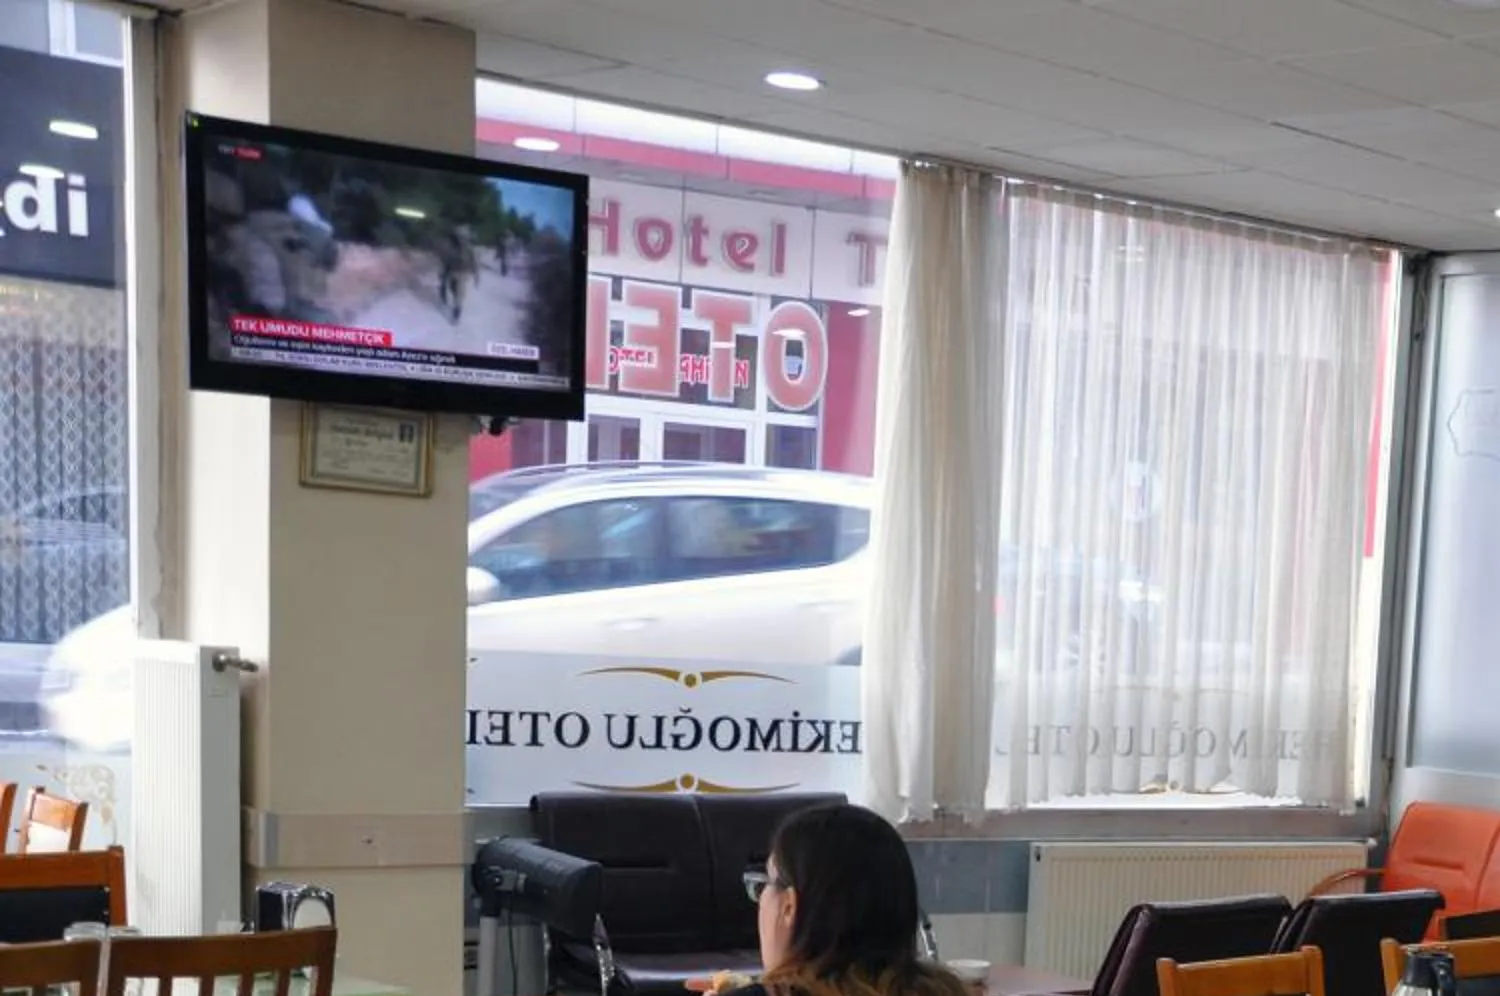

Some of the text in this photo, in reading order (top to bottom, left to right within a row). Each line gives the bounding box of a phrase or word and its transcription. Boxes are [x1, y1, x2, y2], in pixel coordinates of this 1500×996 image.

[0, 172, 89, 237] di
[233, 319, 257, 332] TEK
[259, 321, 310, 337] UMUDU
